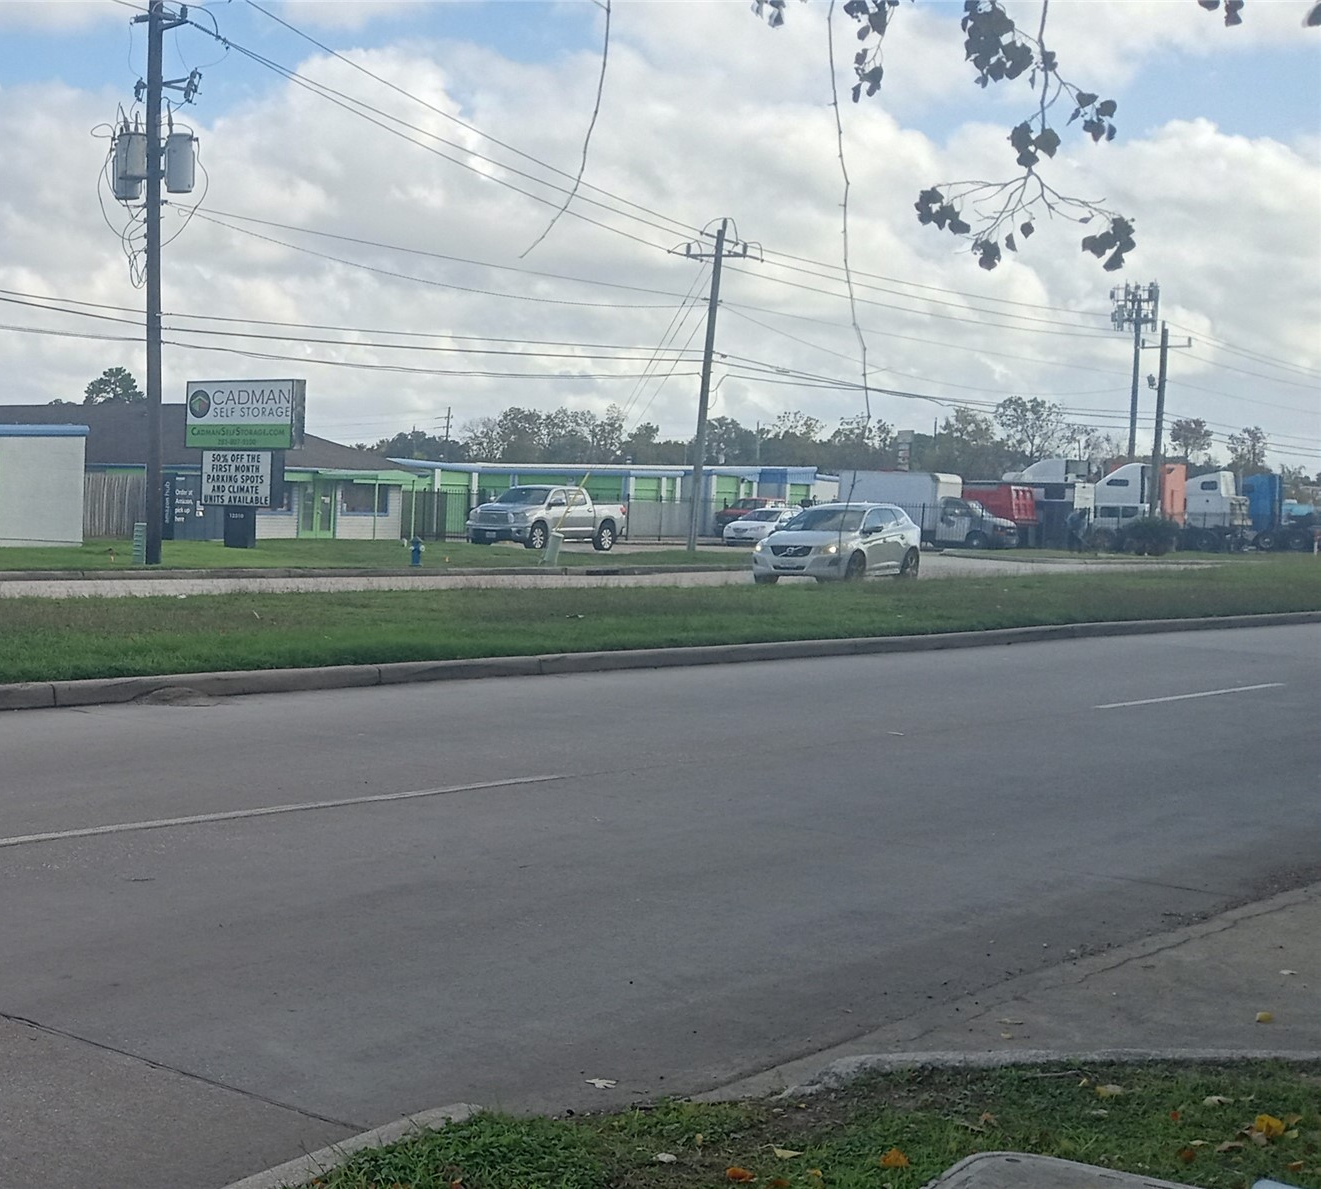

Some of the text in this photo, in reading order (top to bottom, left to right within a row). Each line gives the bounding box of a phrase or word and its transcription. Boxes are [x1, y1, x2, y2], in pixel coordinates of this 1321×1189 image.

[212, 389, 291, 405] CADMAN
[213, 407, 290, 418] SELF STORAGE
[211, 454, 261, 463] 50% OFF THE
[211, 464, 260, 473] FIRST MONTH
[207, 475, 264, 484] PARKING SPOTS
[211, 485, 259, 494] AND CLIMATE
[204, 495, 269, 505] UNITS AVAILABLE
